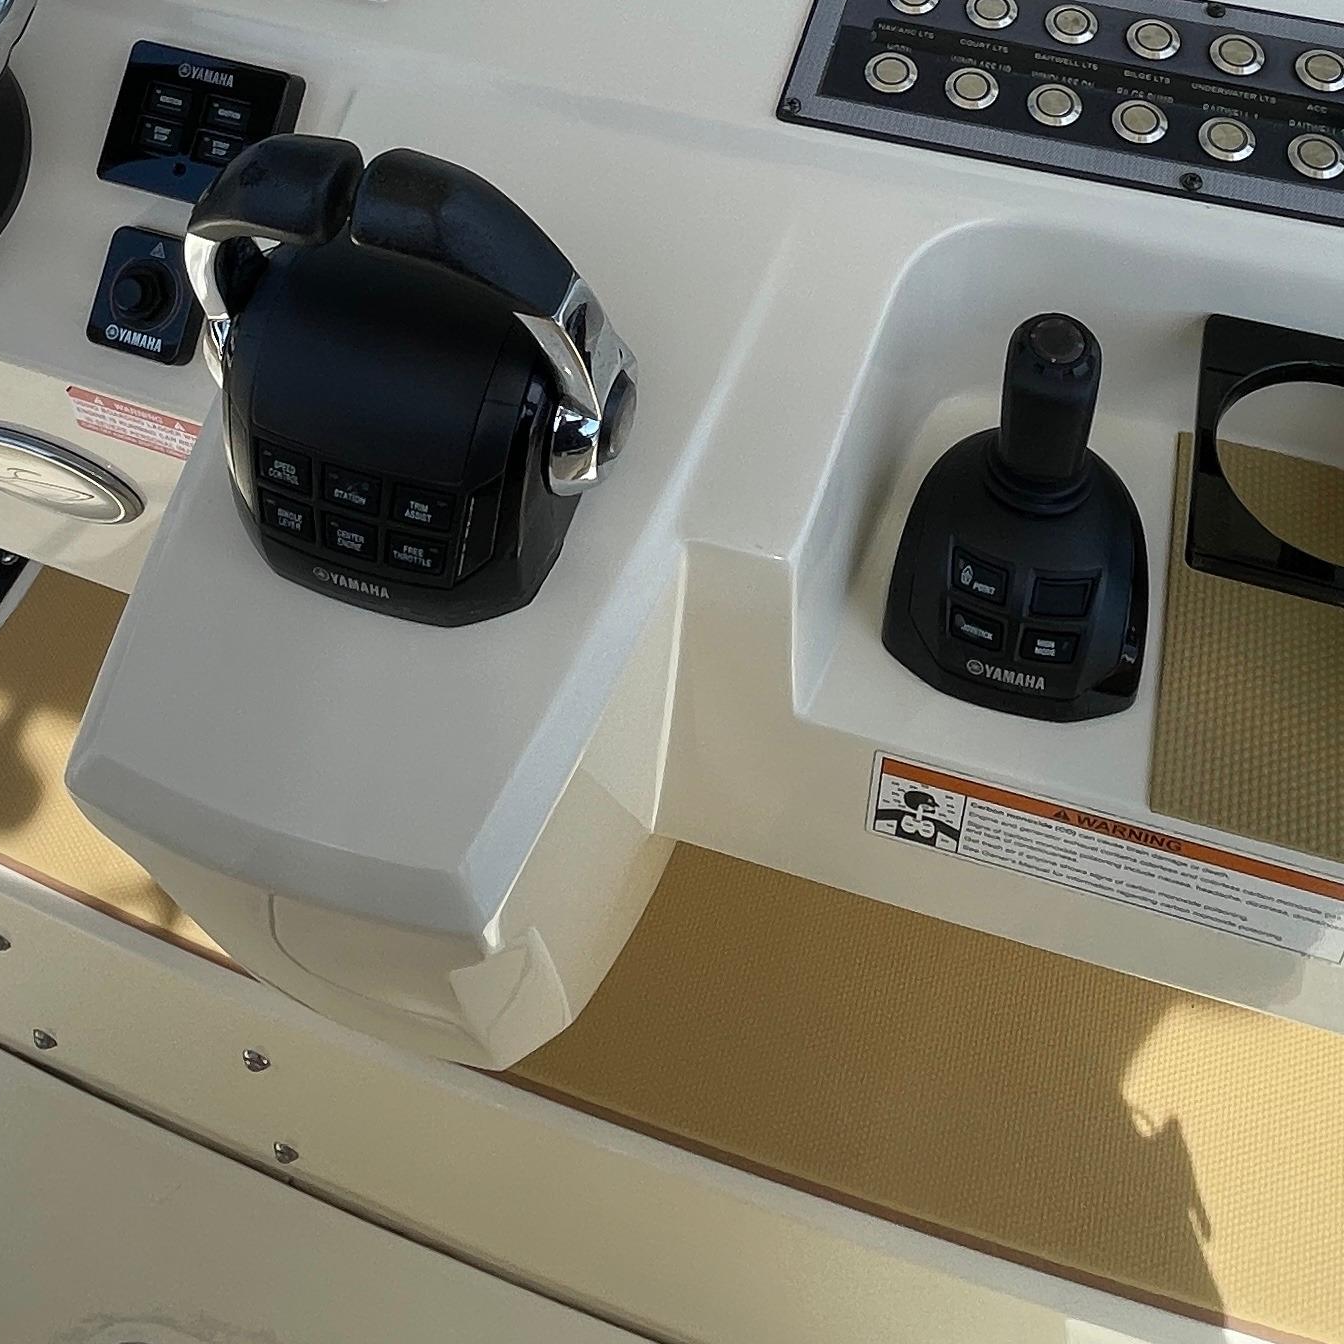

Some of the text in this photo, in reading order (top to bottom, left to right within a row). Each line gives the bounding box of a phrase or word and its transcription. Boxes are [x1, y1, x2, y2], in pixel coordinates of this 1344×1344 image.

[959, 37, 1009, 54] COURT LTS
[1081, 59, 1099, 71] LTS
[190, 66, 234, 88] YAMAHA
[1123, 69, 1171, 85] BILGE LTS
[1191, 82, 1277, 105] UNDERWATER LTS
[1307, 104, 1328, 114] ACC
[118, 327, 162, 353] YAMAHA
[273, 459, 296, 474] SPEED
[268, 467, 299, 486] CONTROL
[333, 488, 366, 505] STATION
[409, 500, 429, 513] TRIM
[404, 508, 432, 524] ASSIST
[393, 550, 432, 568] THROTTLE
[403, 545, 424, 557] FREE
[330, 572, 390, 599] YAMAHA
[984, 663, 1045, 690] YAMAHA
[1076, 815, 1182, 853] WARNING
